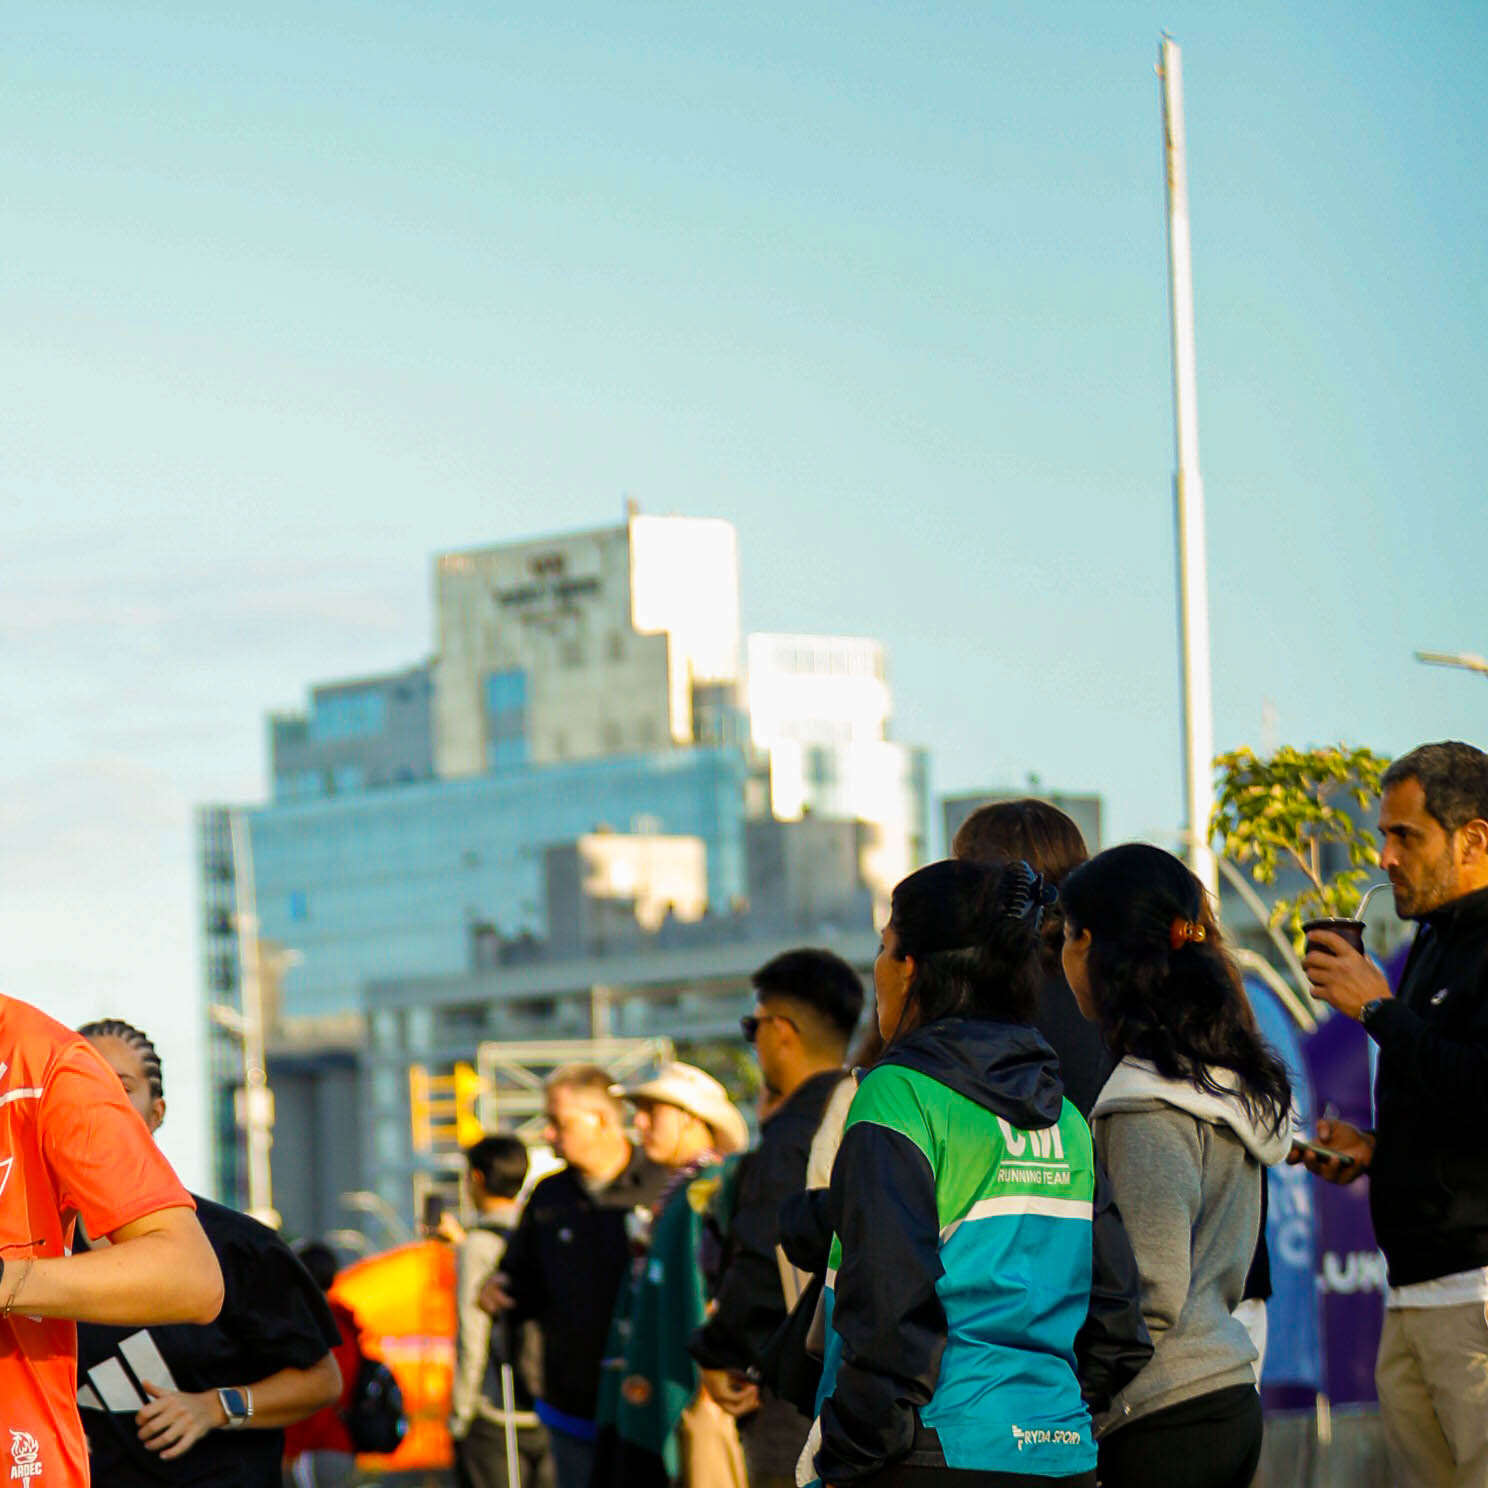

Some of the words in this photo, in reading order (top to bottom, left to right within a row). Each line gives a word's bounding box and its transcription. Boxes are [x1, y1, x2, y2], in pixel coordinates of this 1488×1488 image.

[997, 1168, 1042, 1184] RUNNING
[1043, 1171, 1071, 1185] TEAM
[11, 1462, 43, 1480] ARDEC
